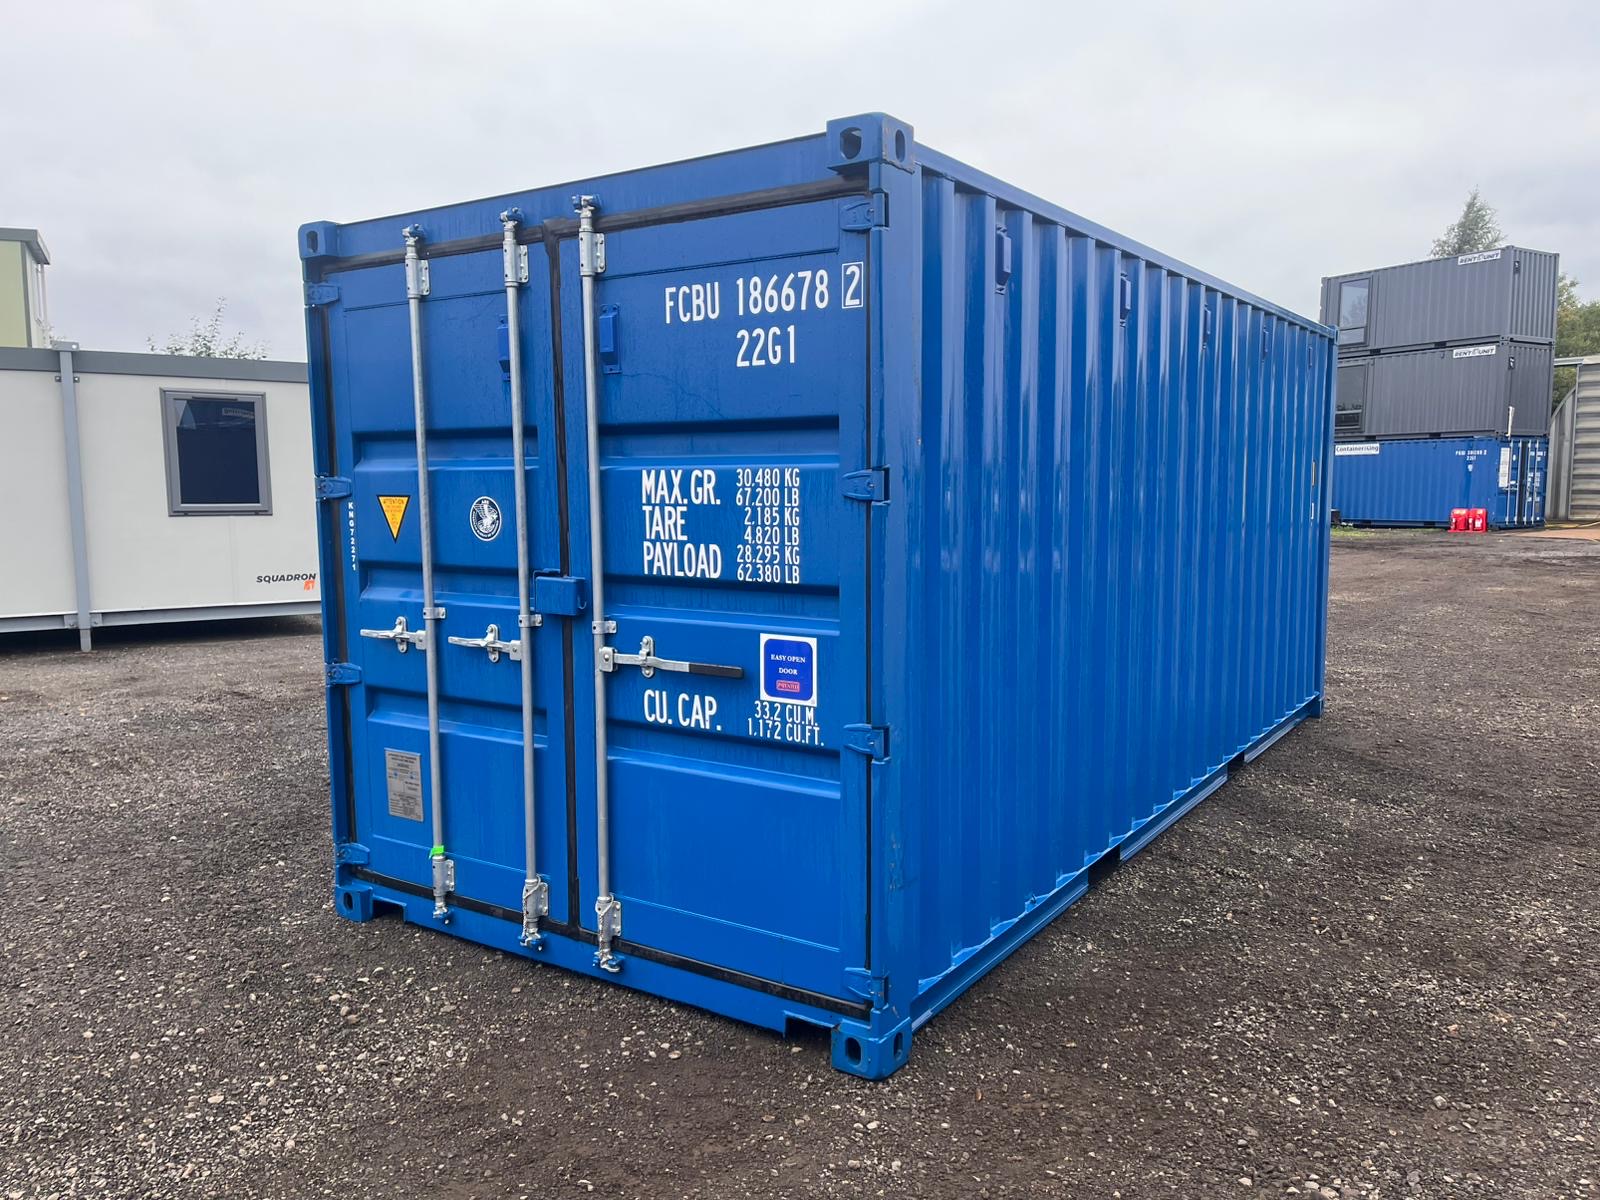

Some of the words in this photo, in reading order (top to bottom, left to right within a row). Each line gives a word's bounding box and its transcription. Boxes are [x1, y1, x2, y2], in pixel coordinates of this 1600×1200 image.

[665, 281, 720, 324] FCBU
[736, 269, 829, 316] 186678
[845, 265, 860, 306] 2
[736, 324, 795, 367] 22G1
[642, 469, 687, 504] MAX.
[690, 469, 721, 505] GR.
[784, 468, 800, 487] KG
[784, 488, 799, 507] LB
[642, 506, 688, 540] TARE
[784, 507, 800, 526] KG
[784, 527, 799, 545] LB
[643, 541, 722, 578] PAYLOAD
[784, 546, 800, 565] KG
[256, 572, 317, 584] SQUADRON
[785, 565, 800, 584] LB
[770, 653, 786, 661] EASY
[787, 655, 806, 663] OPEN
[778, 667, 798, 675] DOOR
[644, 689, 672, 725] CU.
[678, 693, 722, 732] CAP.
[754, 700, 781, 721] 33.2
